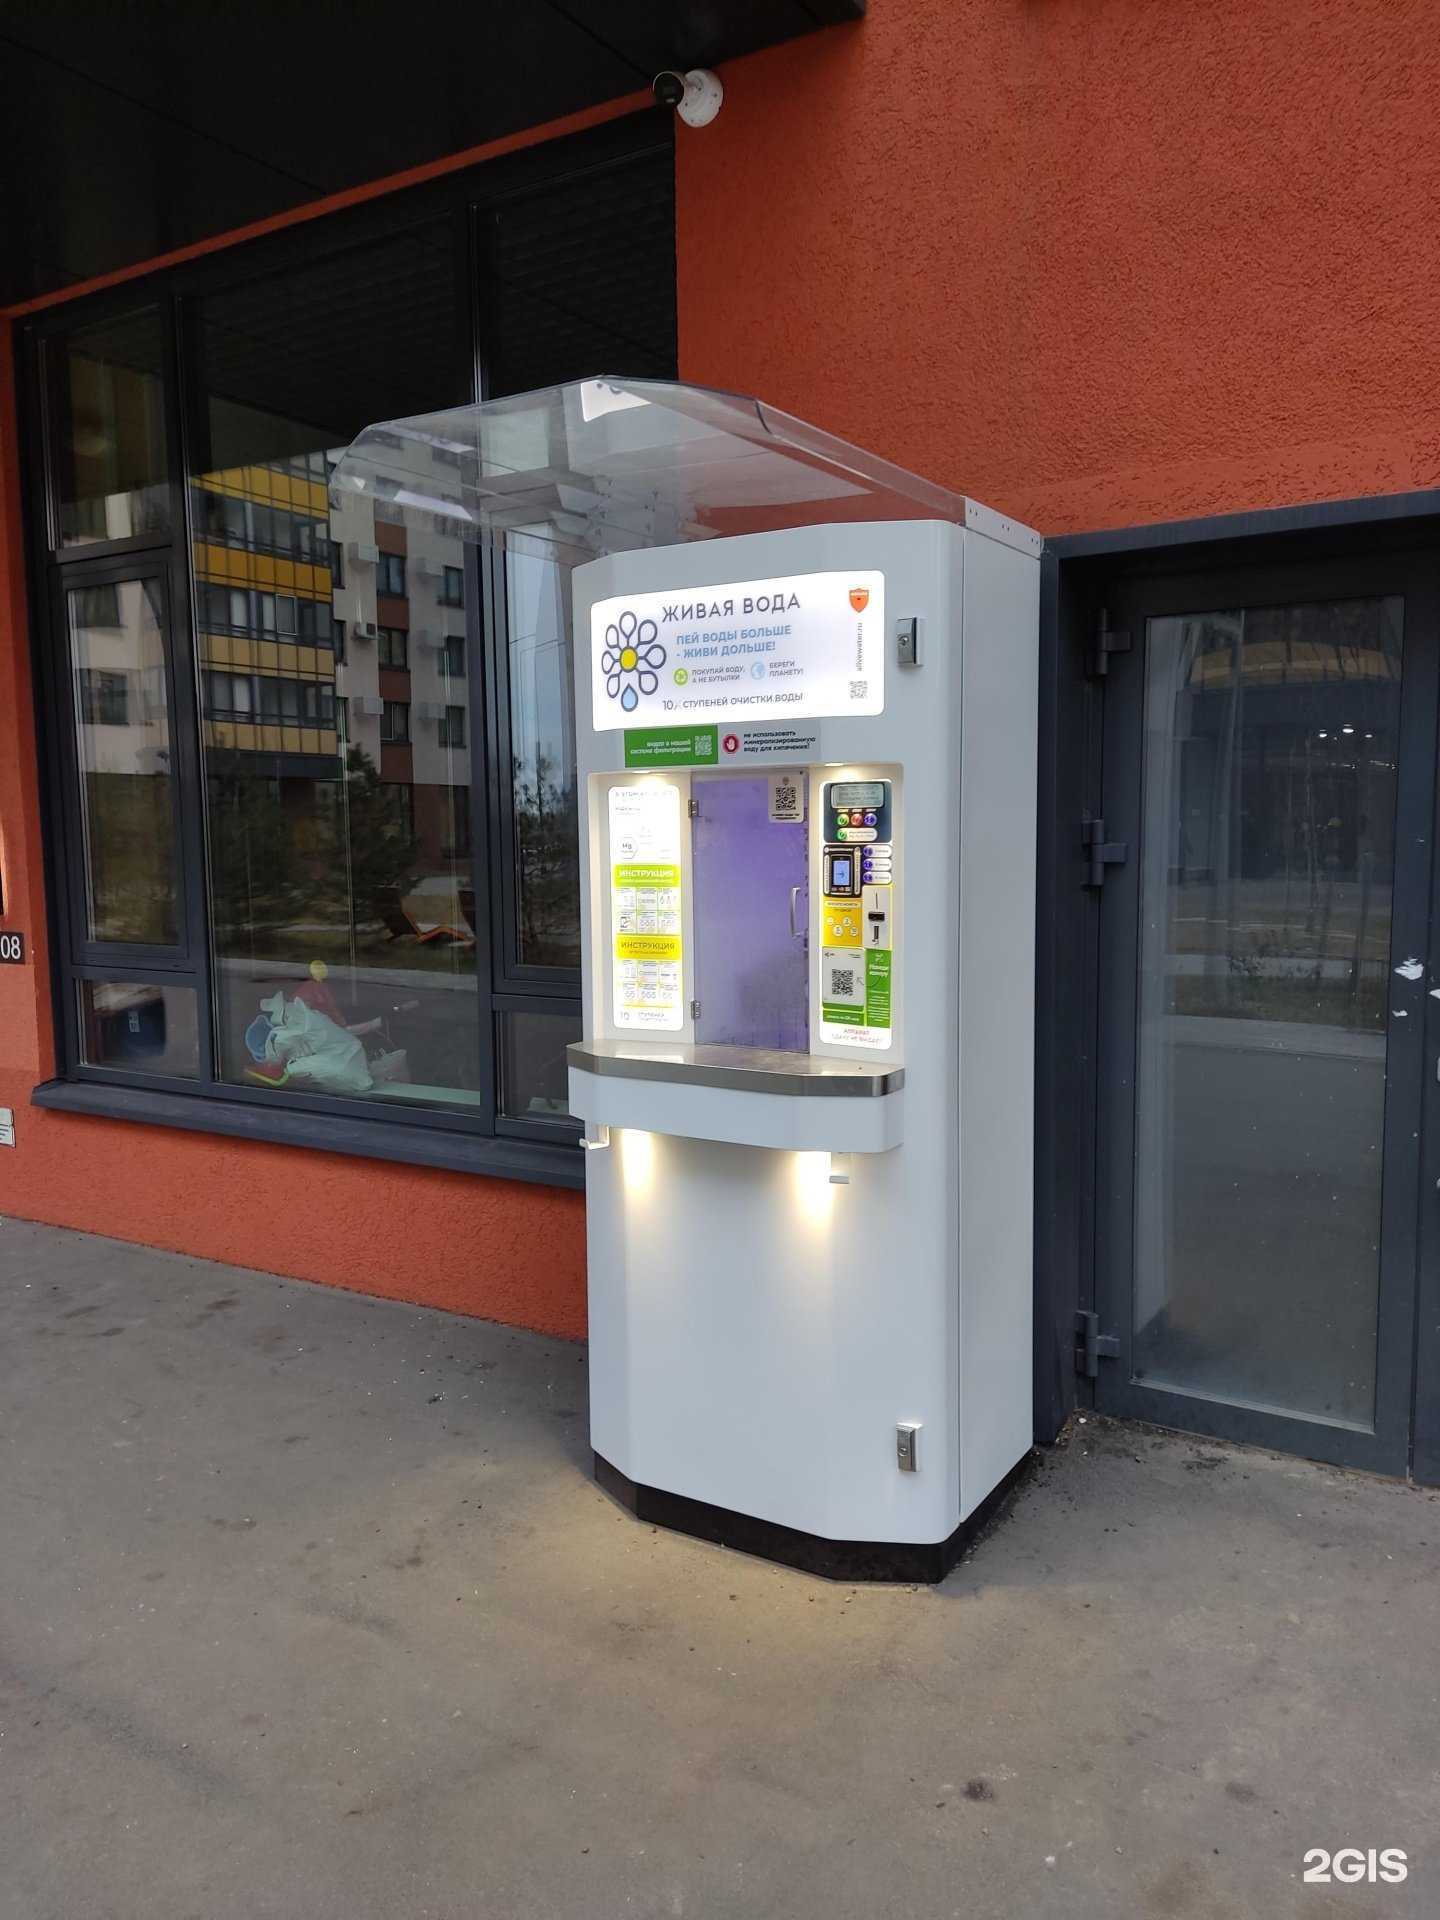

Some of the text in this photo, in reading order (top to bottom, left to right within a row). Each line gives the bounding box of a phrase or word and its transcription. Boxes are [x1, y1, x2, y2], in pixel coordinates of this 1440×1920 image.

[662, 593, 801, 622] ЖИВАЯ ВОДА
[676, 625, 792, 645] ПЕЙ ВОДЫ БОЛЬШЕ
[683, 647, 718, 658] ЖИВИ
[720, 641, 776, 657] ДОЛЬШЕ!
[691, 666, 724, 676] ПОКУПАЙ
[769, 660, 795, 669] БЕРЕГИ
[708, 674, 741, 683] БУТЫЛКИ
[682, 697, 728, 708] СТУПЕНЕЙ
[730, 694, 773, 705] ОЧИСТКИ
[774, 692, 804, 703] ВОДЫ
[621, 942, 675, 950] ИНСТРУКЦИЯ
